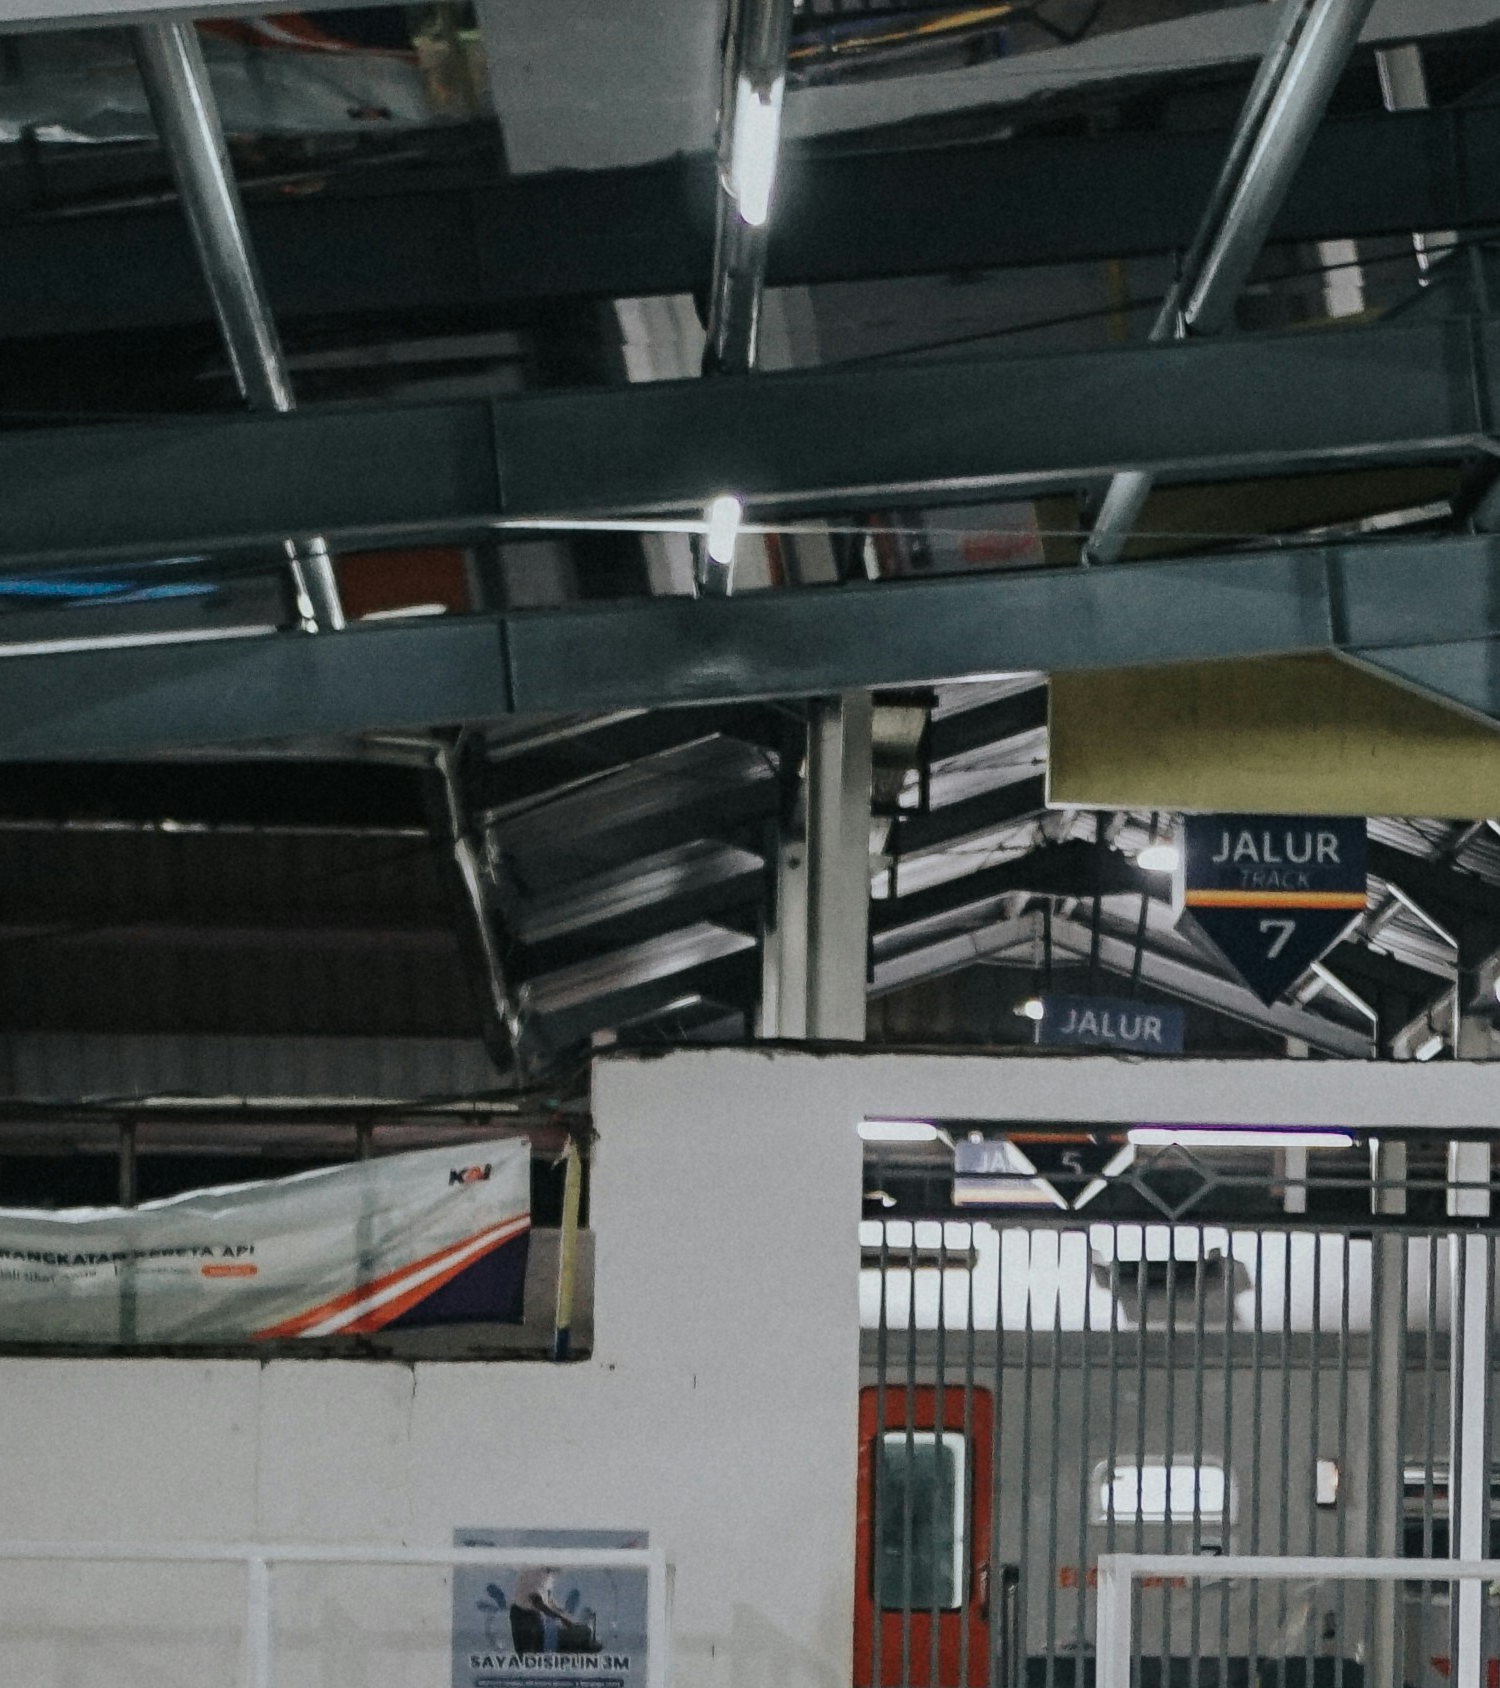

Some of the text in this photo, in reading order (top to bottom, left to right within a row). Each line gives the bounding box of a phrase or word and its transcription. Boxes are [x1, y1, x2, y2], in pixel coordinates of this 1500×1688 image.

[1212, 830, 1341, 864] JALUR
[1240, 869, 1310, 889] TRACK
[1259, 919, 1296, 960] 7
[1059, 1008, 1162, 1044] JALUR
[222, 1244, 255, 1258] API
[470, 1655, 519, 1670] SAYA
[524, 1655, 599, 1670] DISIPLIN
